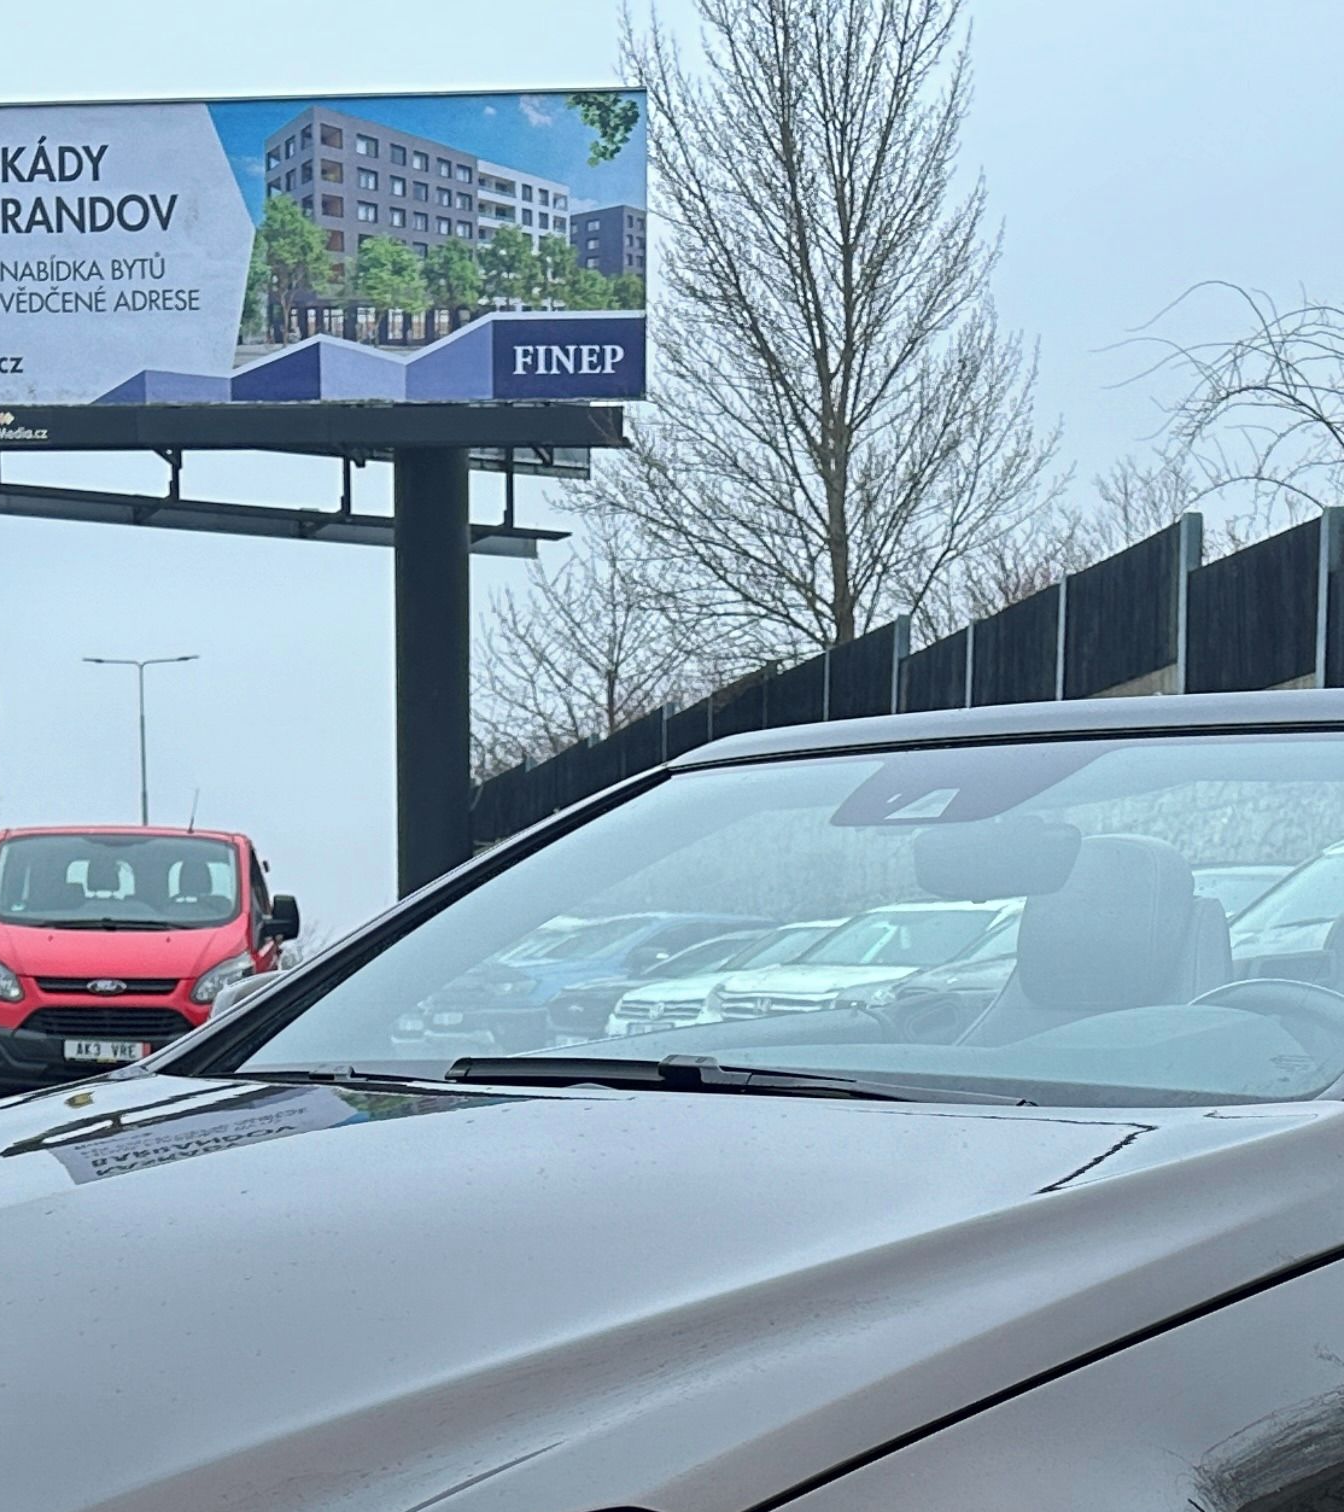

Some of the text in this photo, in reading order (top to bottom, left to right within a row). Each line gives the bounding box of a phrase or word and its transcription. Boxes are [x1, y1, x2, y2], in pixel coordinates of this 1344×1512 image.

[0, 254, 104, 282] NABÍDKA
[110, 252, 166, 280] BYTŮ
[113, 290, 200, 312] ADRESE
[512, 344, 625, 375] FINEP
